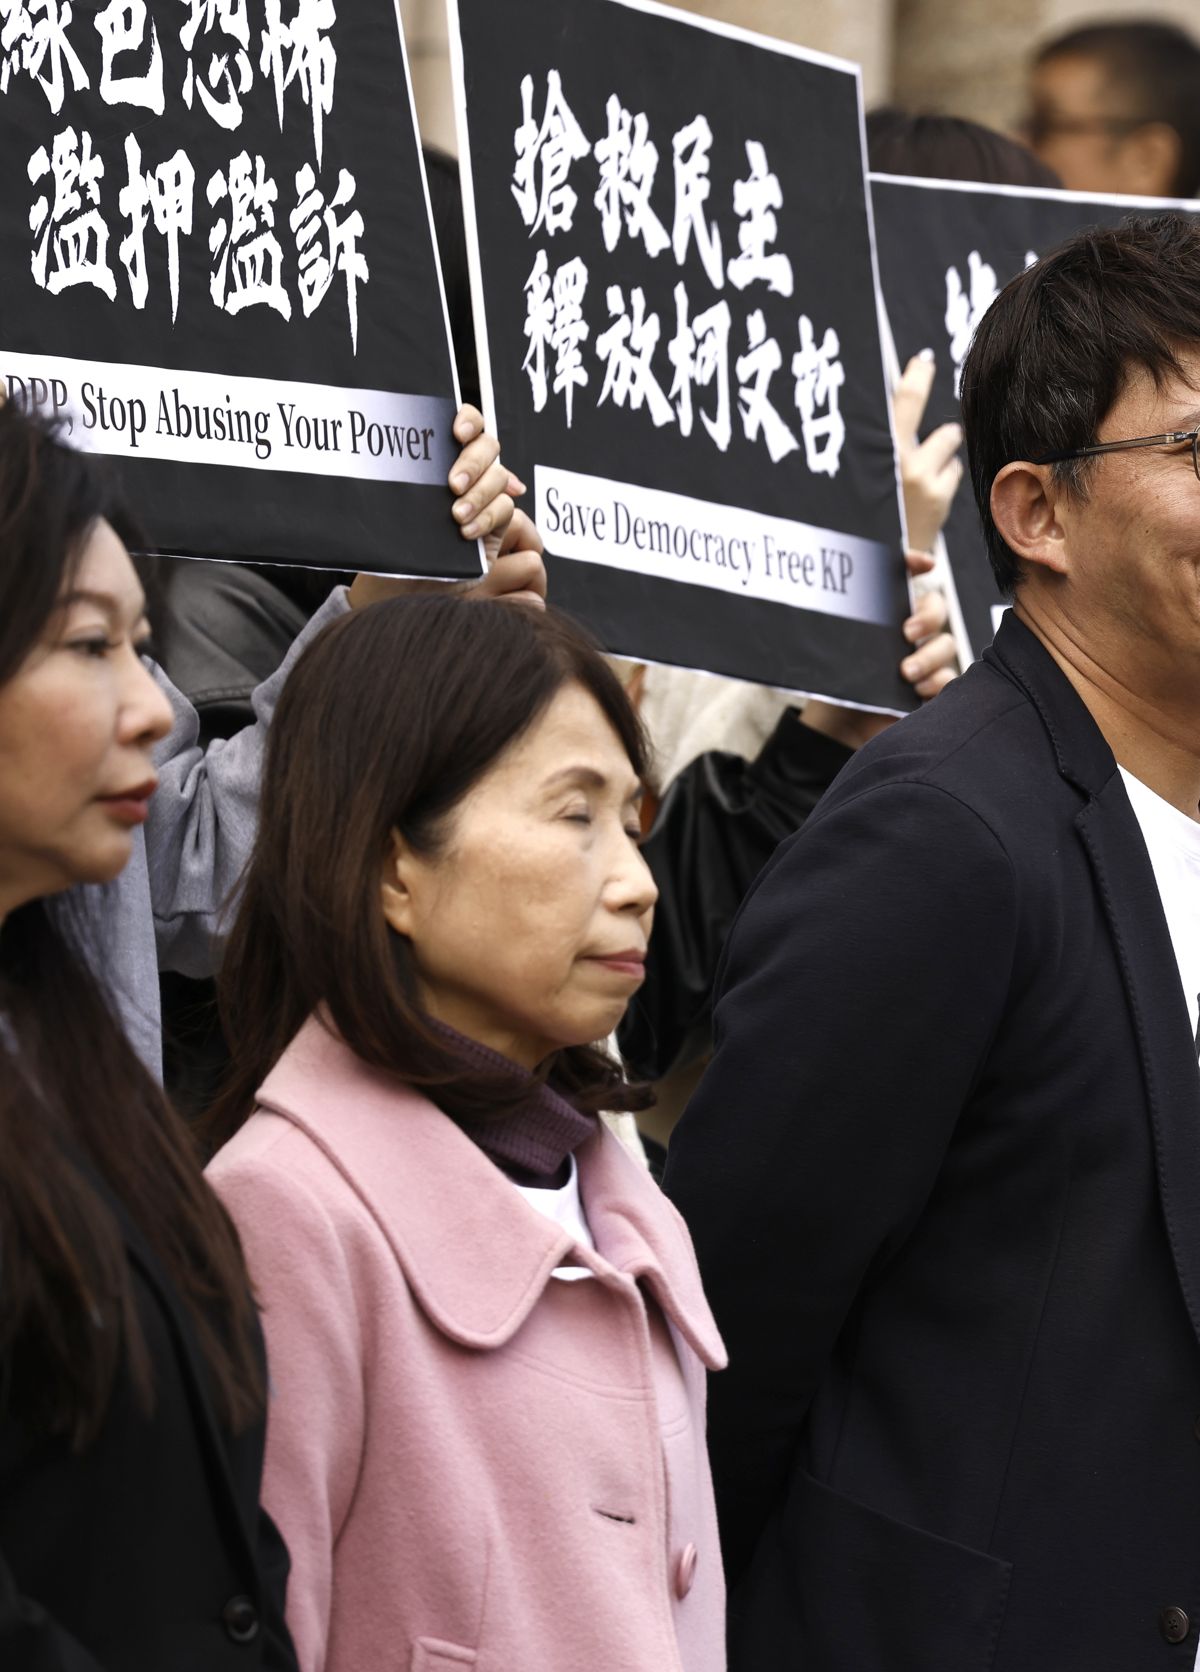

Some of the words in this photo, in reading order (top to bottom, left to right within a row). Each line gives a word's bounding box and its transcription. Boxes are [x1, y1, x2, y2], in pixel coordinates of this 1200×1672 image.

[27, 125, 370, 357] 濫押濫訴
[511, 68, 794, 298] 搶救民主
[81, 382, 147, 448] Stop
[155, 387, 272, 460] Abusing
[276, 402, 343, 452] Your
[347, 410, 435, 462] Power
[521, 248, 846, 478] 釋放柯文哲
[545, 486, 606, 542] Save
[613, 501, 757, 585] Democracy
[762, 534, 815, 587] Free
[820, 546, 854, 596] KP
